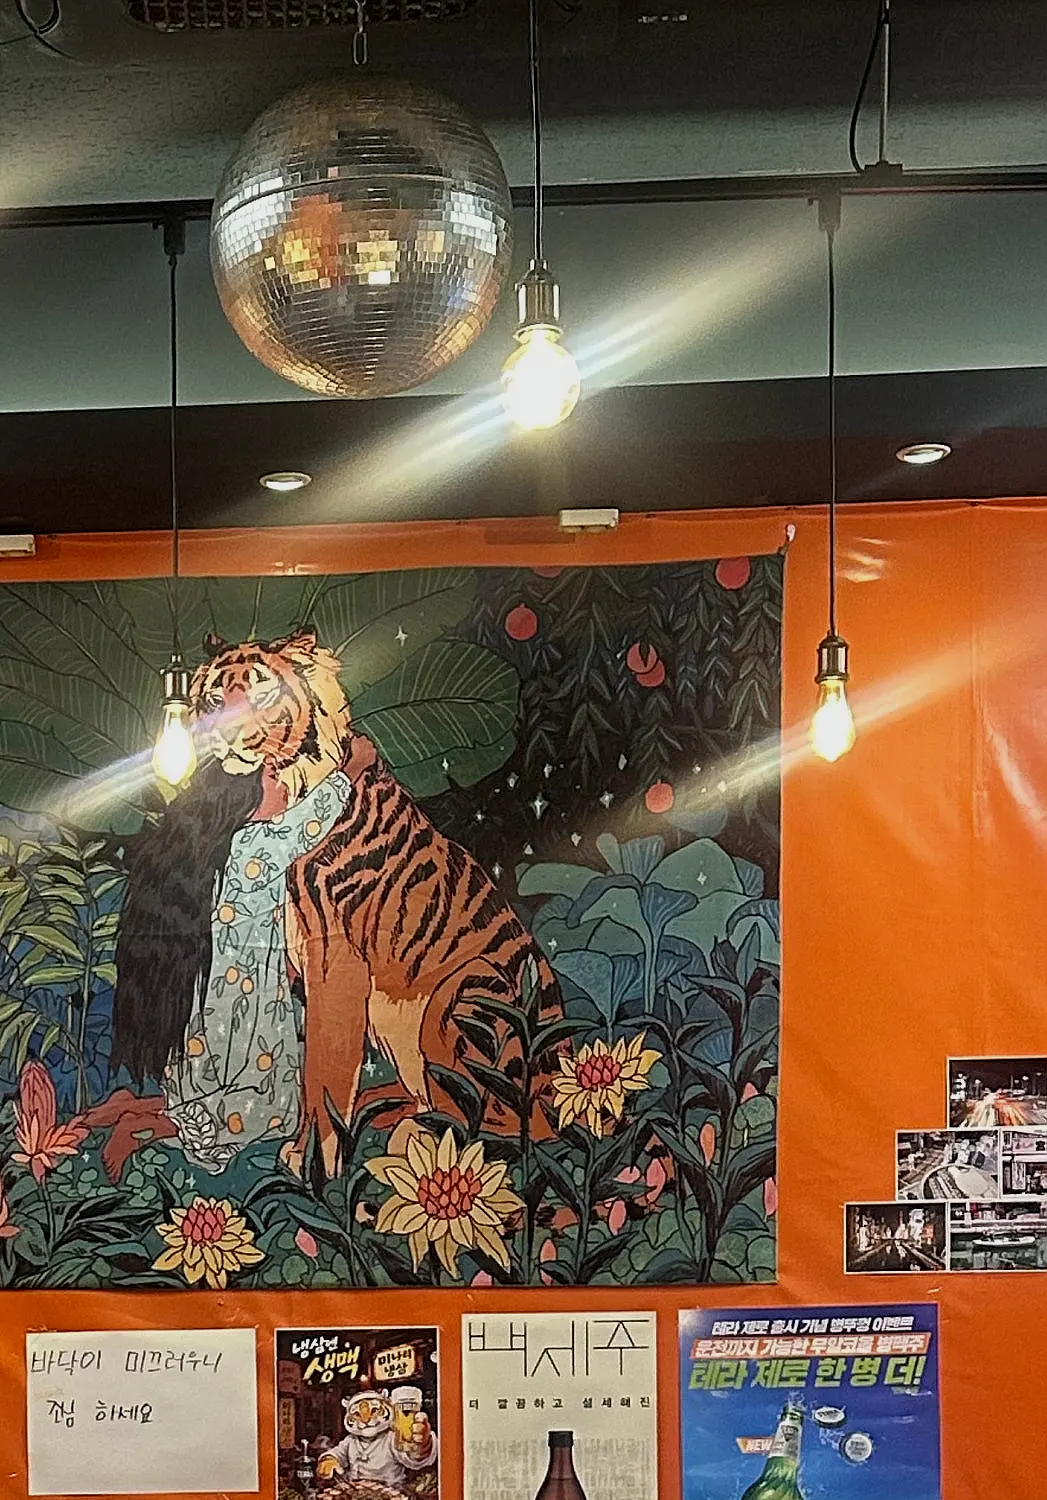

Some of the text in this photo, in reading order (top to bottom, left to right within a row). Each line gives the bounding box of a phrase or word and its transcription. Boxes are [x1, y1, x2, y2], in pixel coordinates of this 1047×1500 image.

[378, 1349, 412, 1366] 미나리
[759, 1337, 810, 1356] 가능한
[31, 1350, 222, 1375] 바닥이 미끄러우니
[303, 1346, 360, 1382] 생맥
[688, 1356, 927, 1389] 테라 제로 한 병 더!
[96, 1400, 152, 1423] 하세요
[469, 1399, 479, 1410] 더
